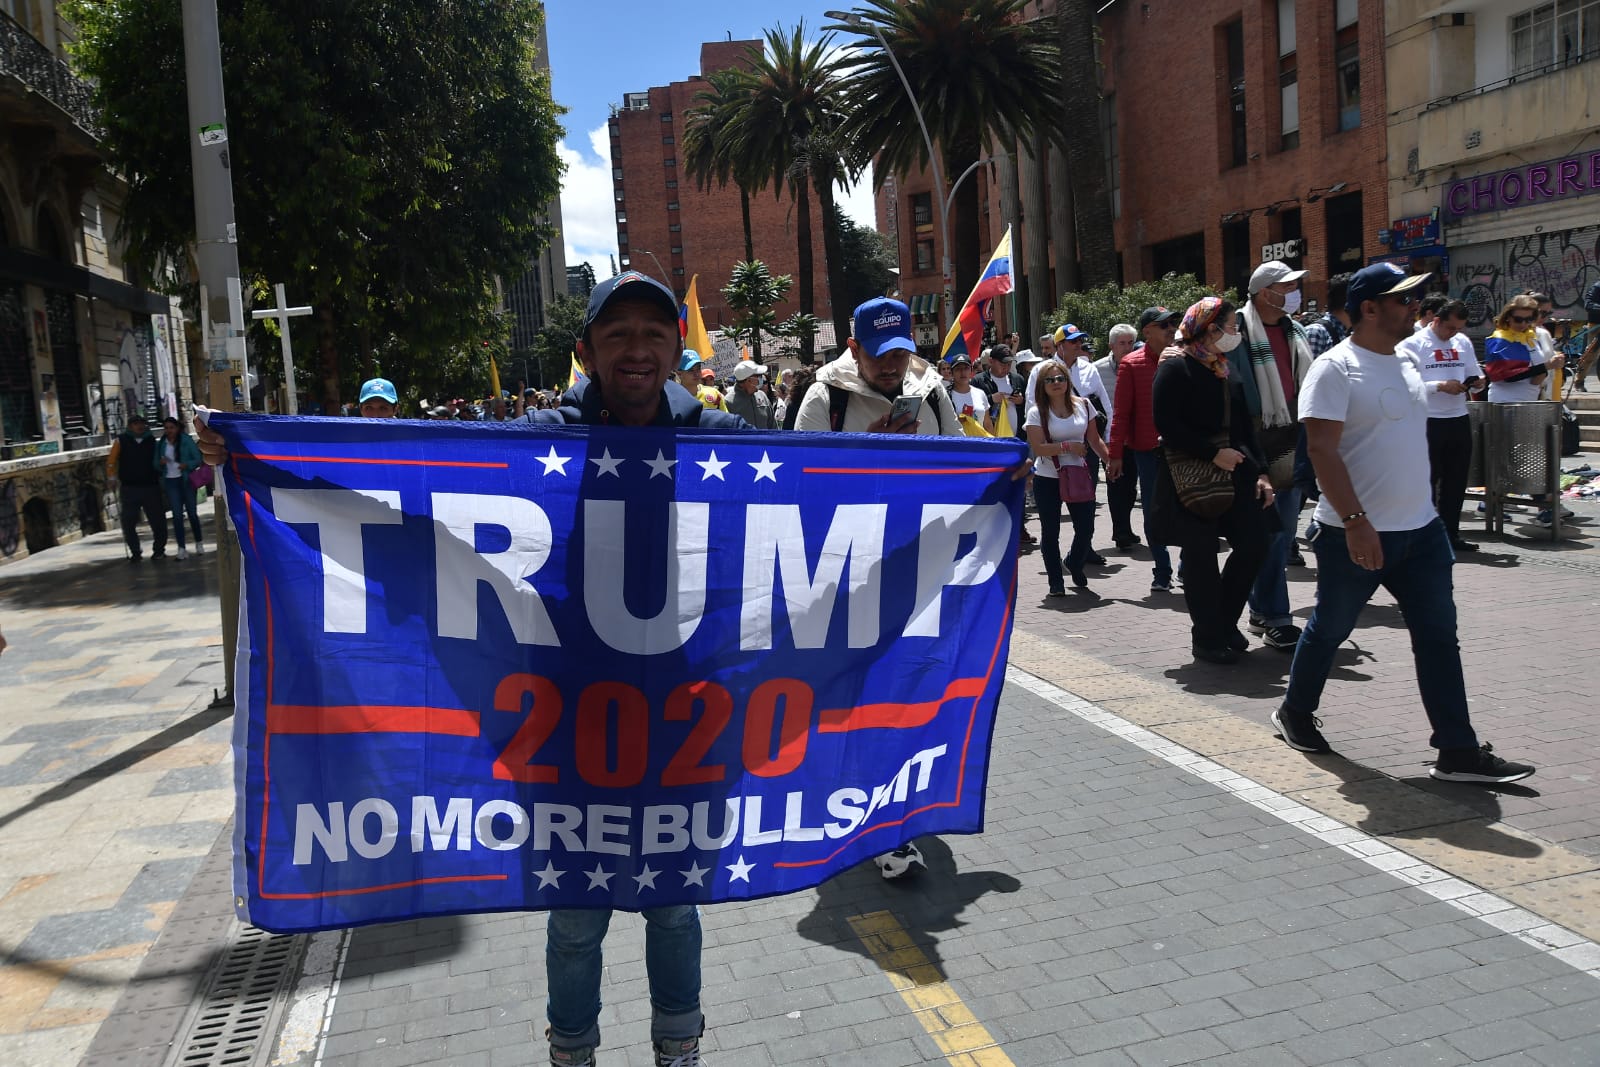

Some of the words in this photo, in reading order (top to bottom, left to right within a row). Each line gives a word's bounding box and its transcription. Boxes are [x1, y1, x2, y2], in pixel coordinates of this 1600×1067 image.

[1262, 240, 1296, 262] BBC
[873, 315, 902, 327] EQUIPO
[271, 487, 1013, 656] TRUMP
[492, 673, 815, 788] 2020
[293, 797, 399, 866] NO
[411, 795, 632, 856] MORE
